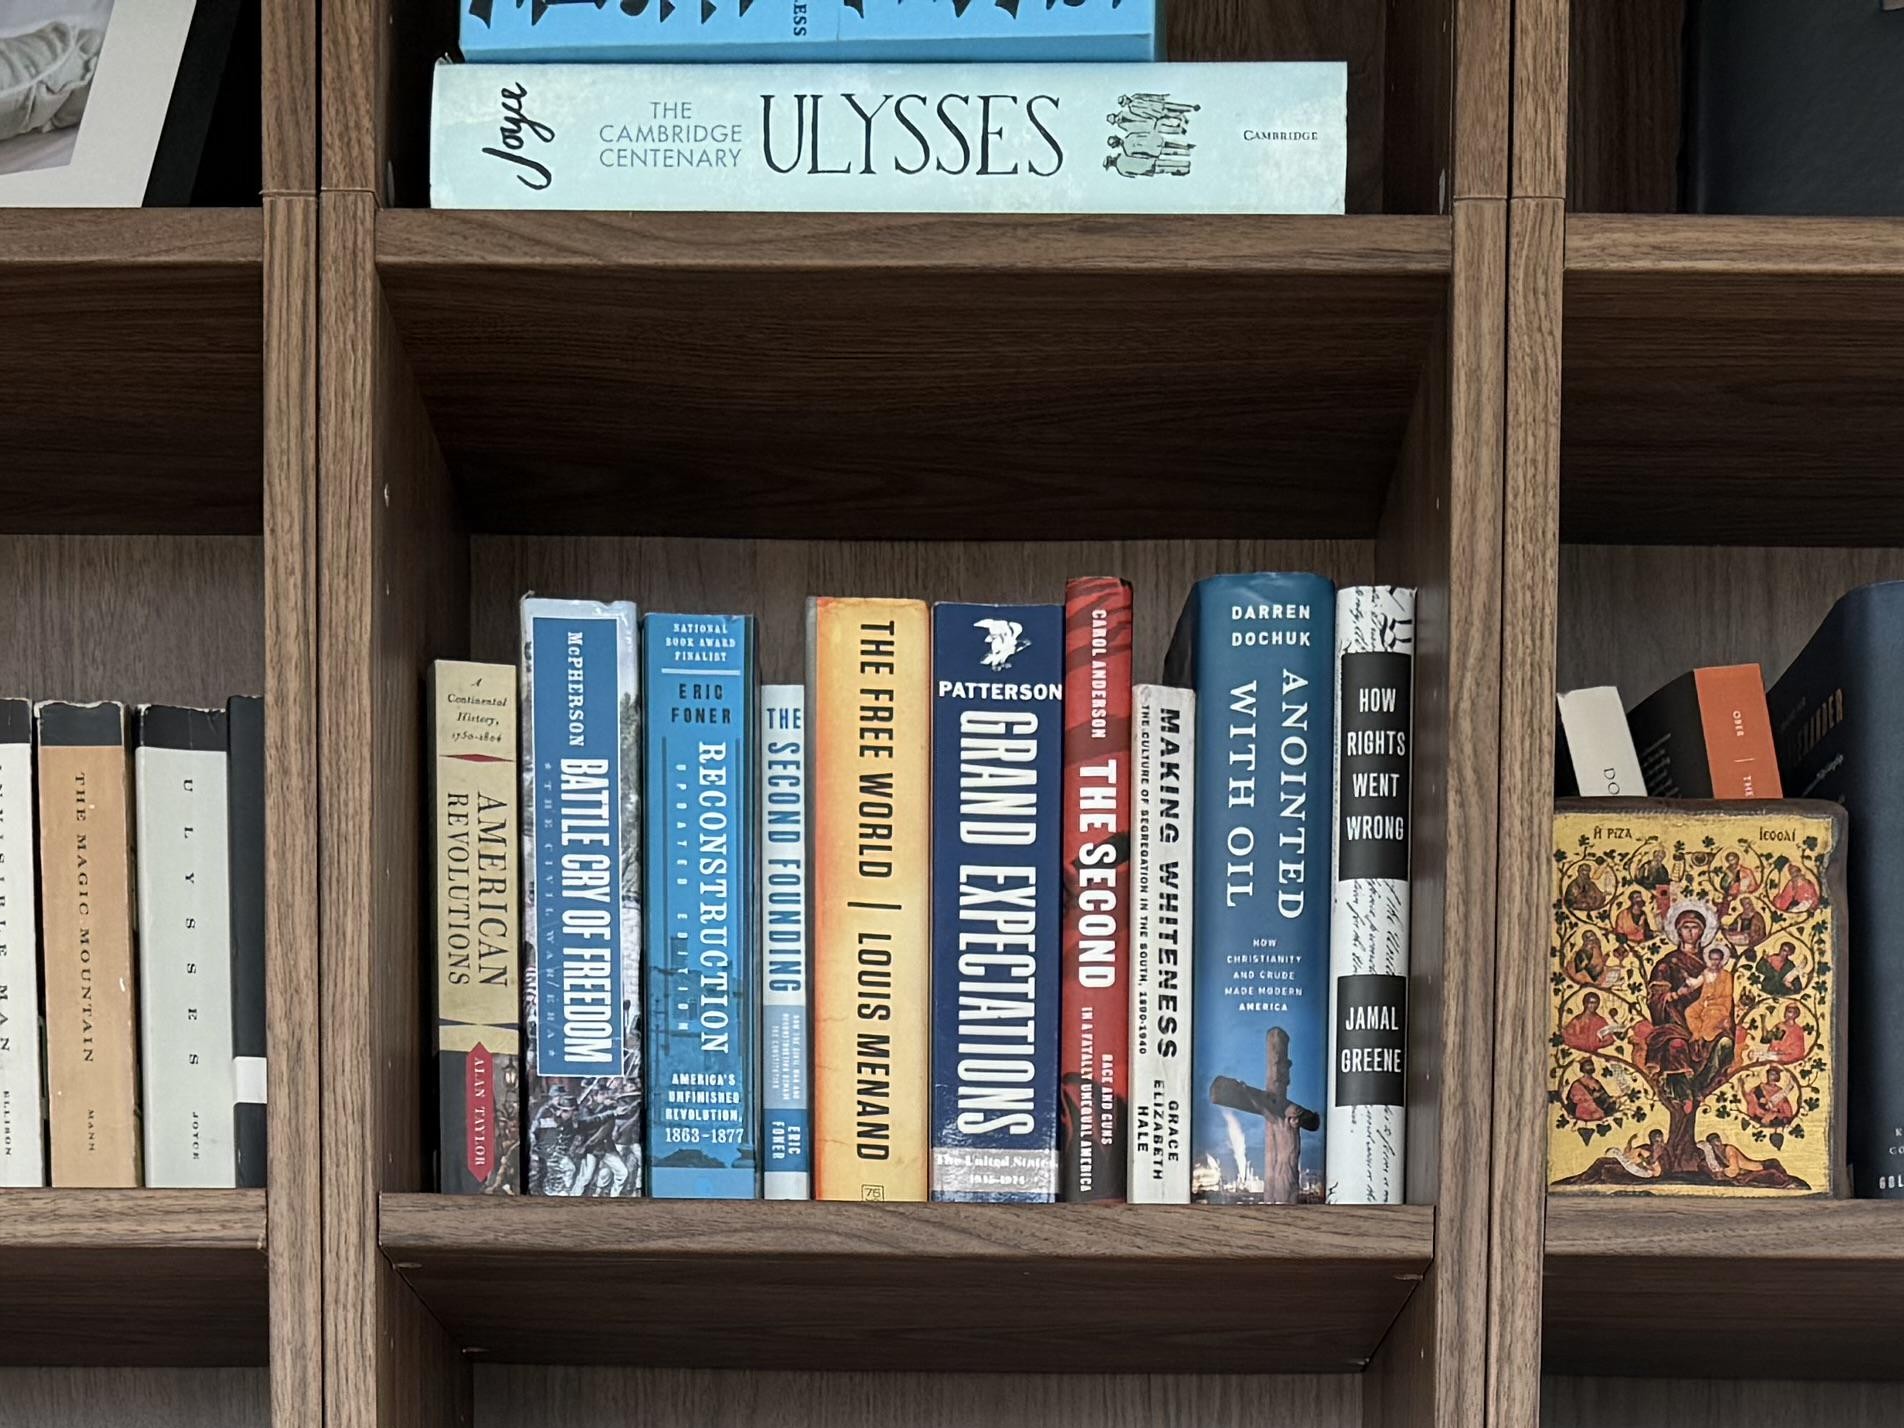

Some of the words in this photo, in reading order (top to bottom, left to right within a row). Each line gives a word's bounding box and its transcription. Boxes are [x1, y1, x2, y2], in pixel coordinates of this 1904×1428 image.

[648, 100, 694, 120] THE
[482, 81, 555, 191] Joyce
[598, 124, 743, 145] CAMBRIDGE
[760, 93, 1065, 177] ULYSSES
[598, 148, 743, 169] CENTENARY
[1231, 604, 1311, 622] DARREN
[1231, 630, 1311, 648] DOCHUK
[938, 680, 1063, 701] PATTERSON
[1359, 687, 1397, 713] HOW
[1346, 729, 1406, 757] RIGHTS
[960, 710, 1036, 844] GRAND
[1352, 772, 1400, 799] WENT
[1347, 814, 1404, 841] WRONG
[958, 865, 1035, 1136] EXPECTATIONS
[1345, 1004, 1400, 1032] JAMAL
[1340, 1045, 1403, 1074] GREENE
